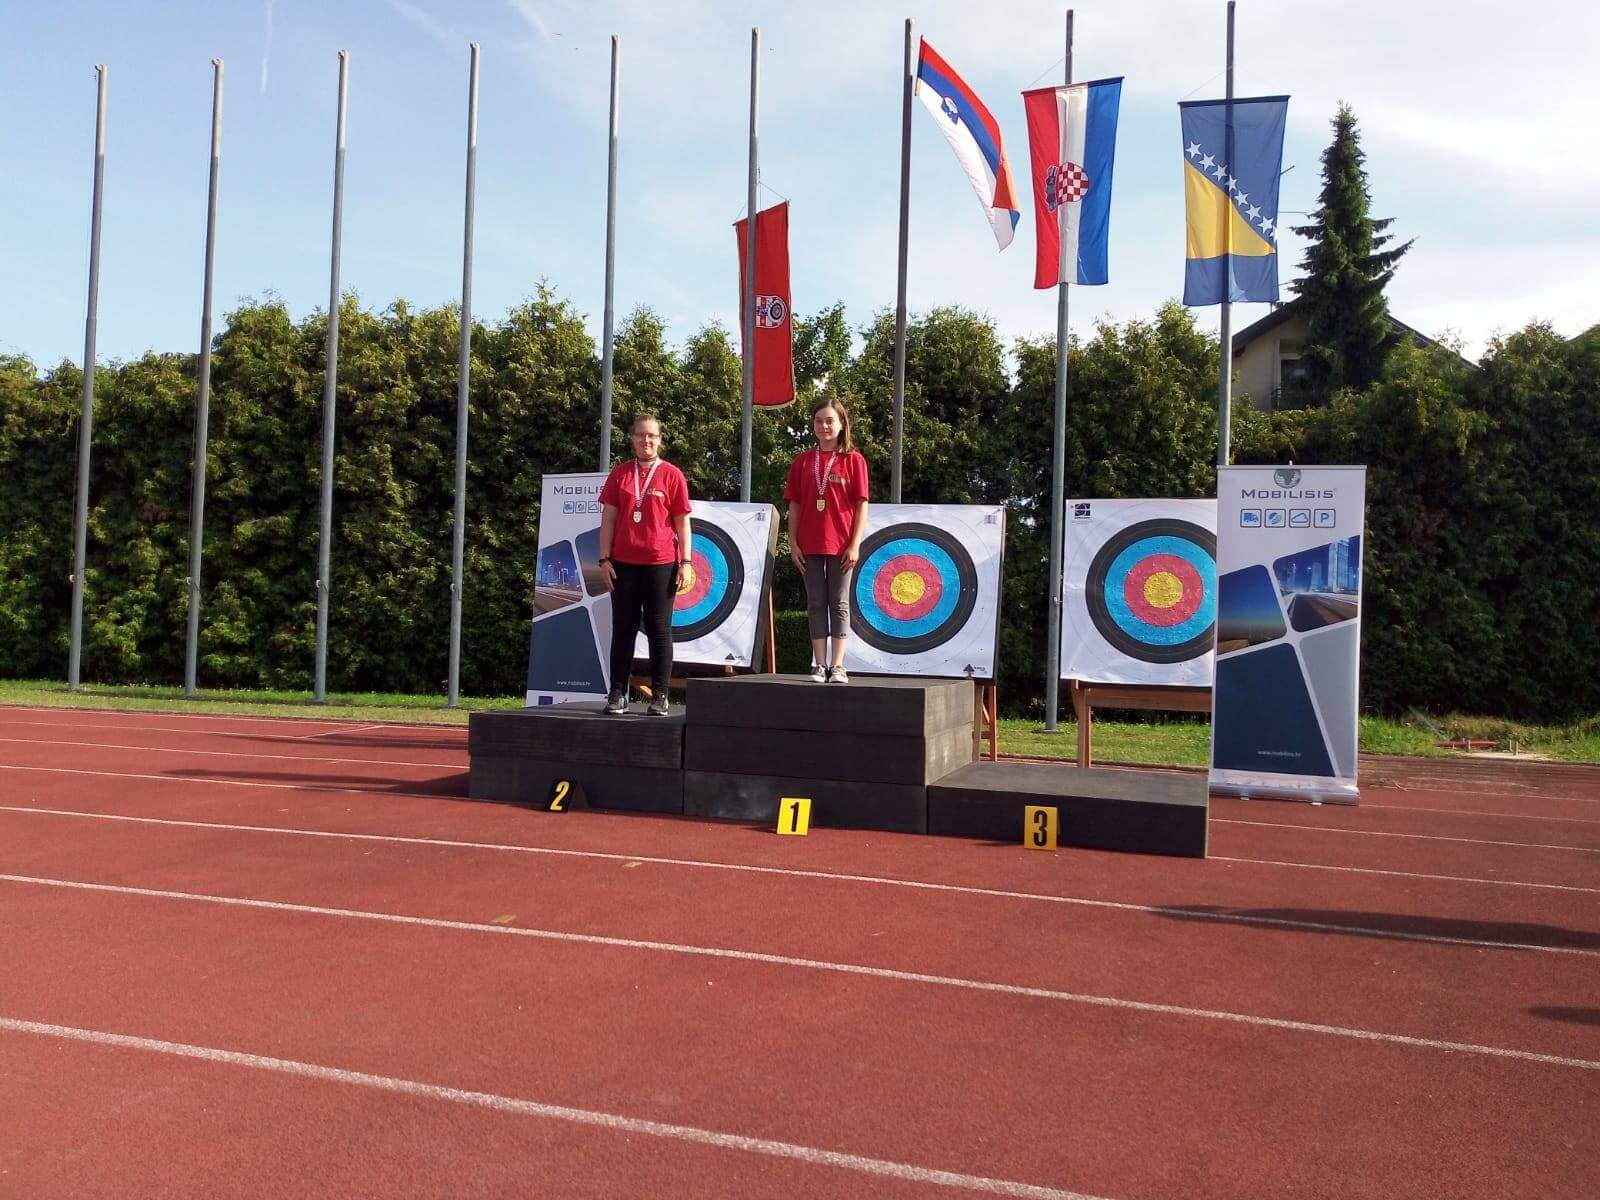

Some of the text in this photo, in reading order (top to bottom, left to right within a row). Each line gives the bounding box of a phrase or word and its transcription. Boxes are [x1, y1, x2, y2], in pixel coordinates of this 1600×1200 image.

[1241, 488, 1334, 499] MOBILISIS
[1320, 512, 1330, 524] P
[550, 781, 570, 811] 2
[790, 801, 800, 832] 1
[1033, 810, 1048, 847] 3
